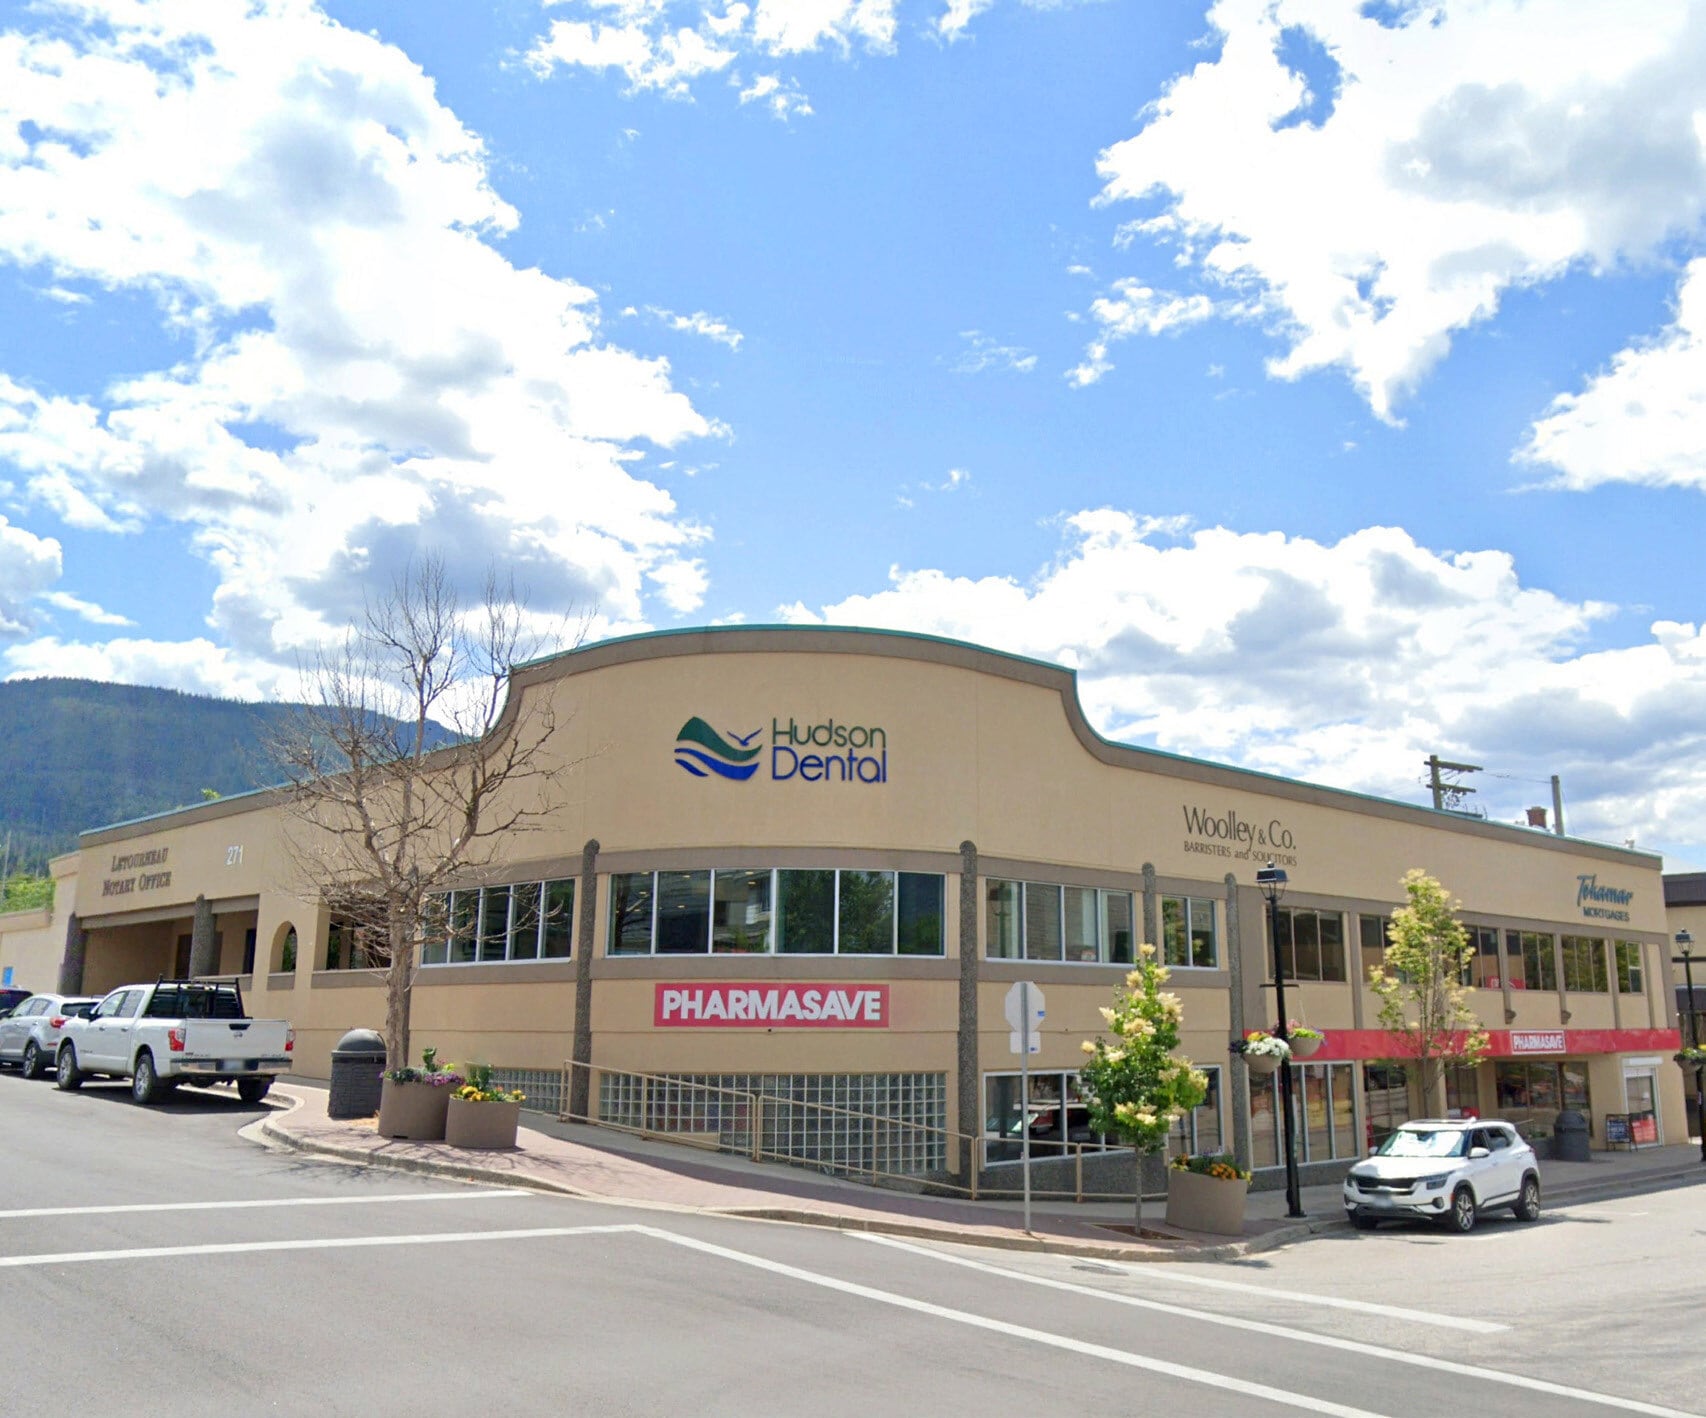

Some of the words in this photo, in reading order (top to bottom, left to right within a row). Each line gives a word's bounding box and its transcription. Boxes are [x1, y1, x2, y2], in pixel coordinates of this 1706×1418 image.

[772, 717, 887, 748] Hudson
[772, 745, 887, 783] Dental
[1183, 805, 1256, 852] Woolley
[1257, 828, 1266, 845] &
[1269, 819, 1297, 850] Co.
[111, 847, 169, 872] LETOURNEAU
[225, 845, 244, 867] 271
[1184, 840, 1232, 858] BARRISTERS
[1234, 849, 1249, 860] and
[1252, 850, 1297, 867] SOLICITORS
[102, 877, 136, 897] NOTARY
[138, 871, 172, 891] OFFICE
[1583, 906, 1630, 922] MORTGAGES
[662, 989, 881, 1020] PHARMASAVE
[1513, 1034, 1563, 1049] PHARMASAVE
